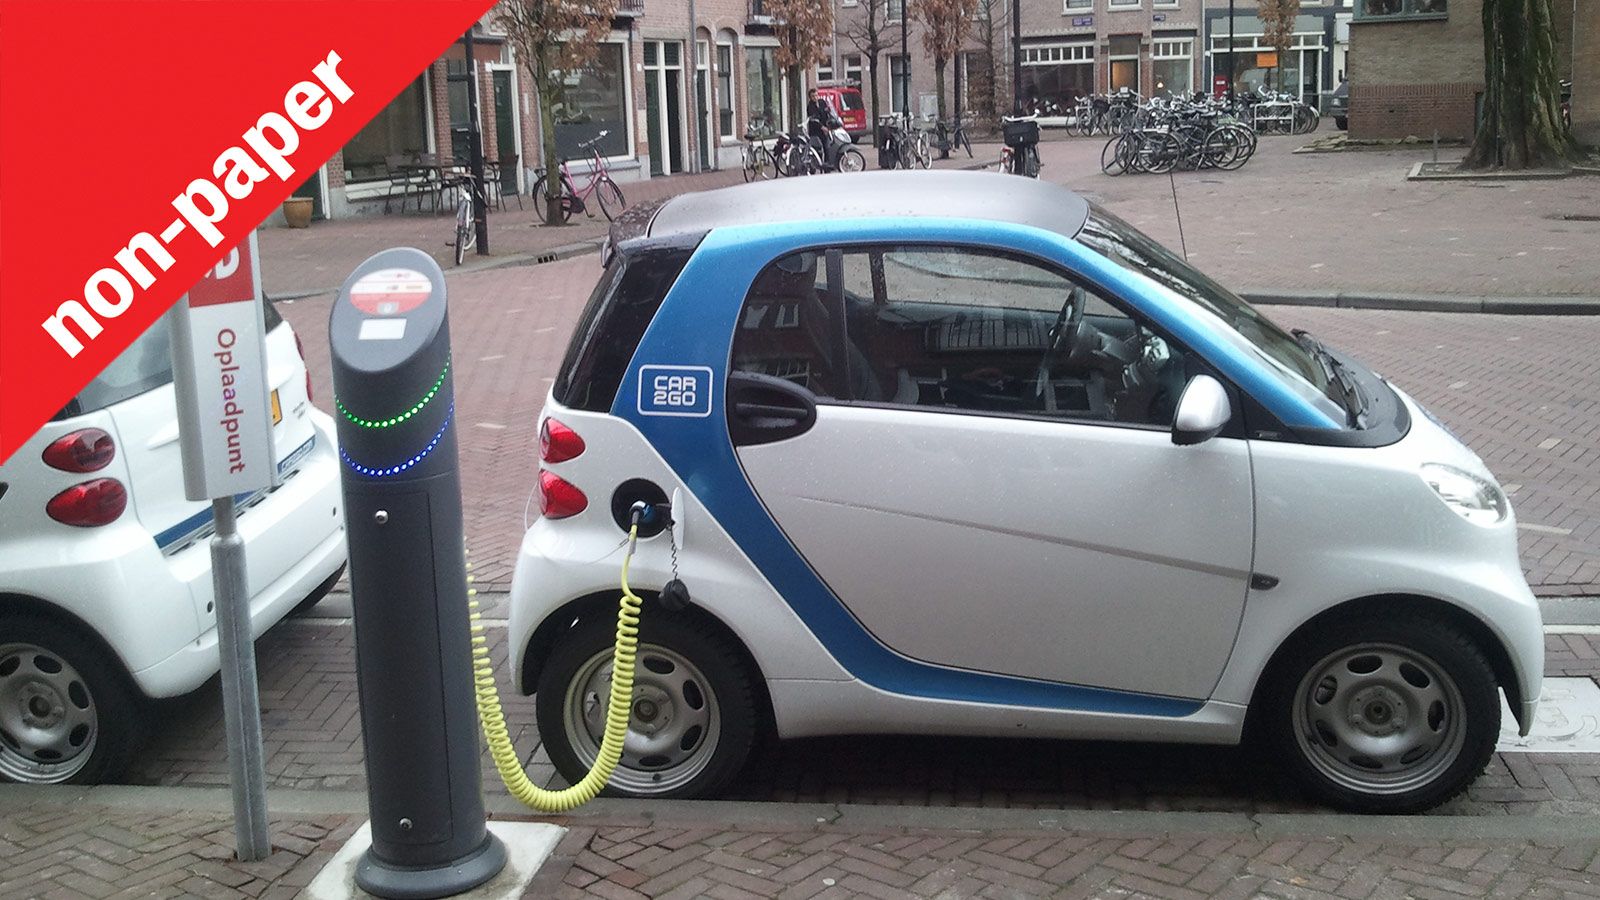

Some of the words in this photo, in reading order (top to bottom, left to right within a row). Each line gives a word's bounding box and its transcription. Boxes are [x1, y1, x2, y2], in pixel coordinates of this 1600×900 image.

[654, 375, 697, 391] CAR
[214, 328, 246, 474] Oplaadpunt
[653, 390, 696, 406] 2GO
